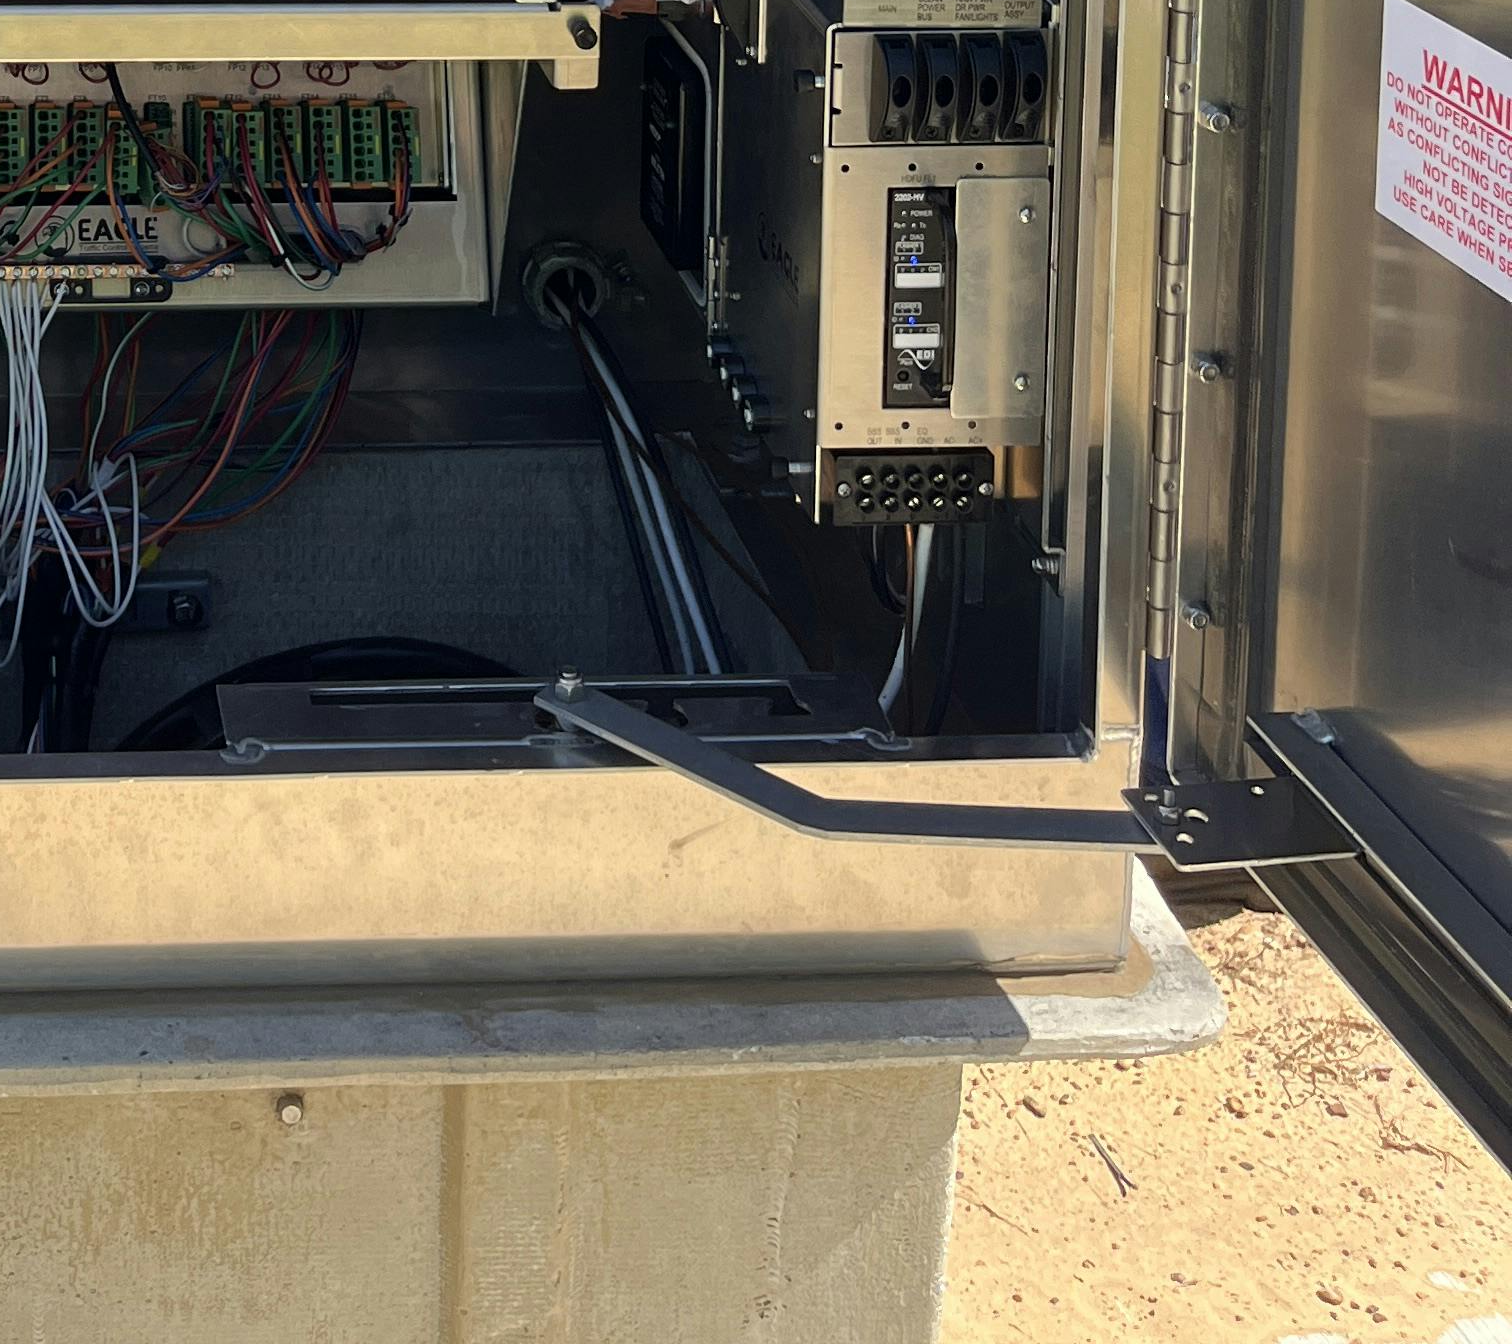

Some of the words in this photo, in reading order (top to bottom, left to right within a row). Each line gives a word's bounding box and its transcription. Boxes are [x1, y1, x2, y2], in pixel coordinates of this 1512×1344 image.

[916, 13, 933, 21] BUS
[917, 4, 946, 12] POWER
[968, 3, 986, 11] PWR
[1004, 0, 1035, 9] OUTPUT
[1386, 71, 1405, 96] DO
[1406, 82, 1432, 110] NOT
[1434, 100, 1495, 150] OPERATE
[1394, 96, 1450, 144] WITHOUT
[1387, 115, 1405, 139] AS
[1406, 127, 1489, 192] CONFLICTING
[1422, 159, 1448, 186] NOT
[1451, 178, 1468, 202] BE
[910, 209, 933, 217] POWER
[1403, 168, 1433, 201] HIGH
[1435, 190, 1495, 243] VOLTAGE
[1393, 184, 1418, 213] USE
[1419, 202, 1454, 239] CARE
[1457, 225, 1495, 265] WHEN
[916, 349, 935, 361] EDI
